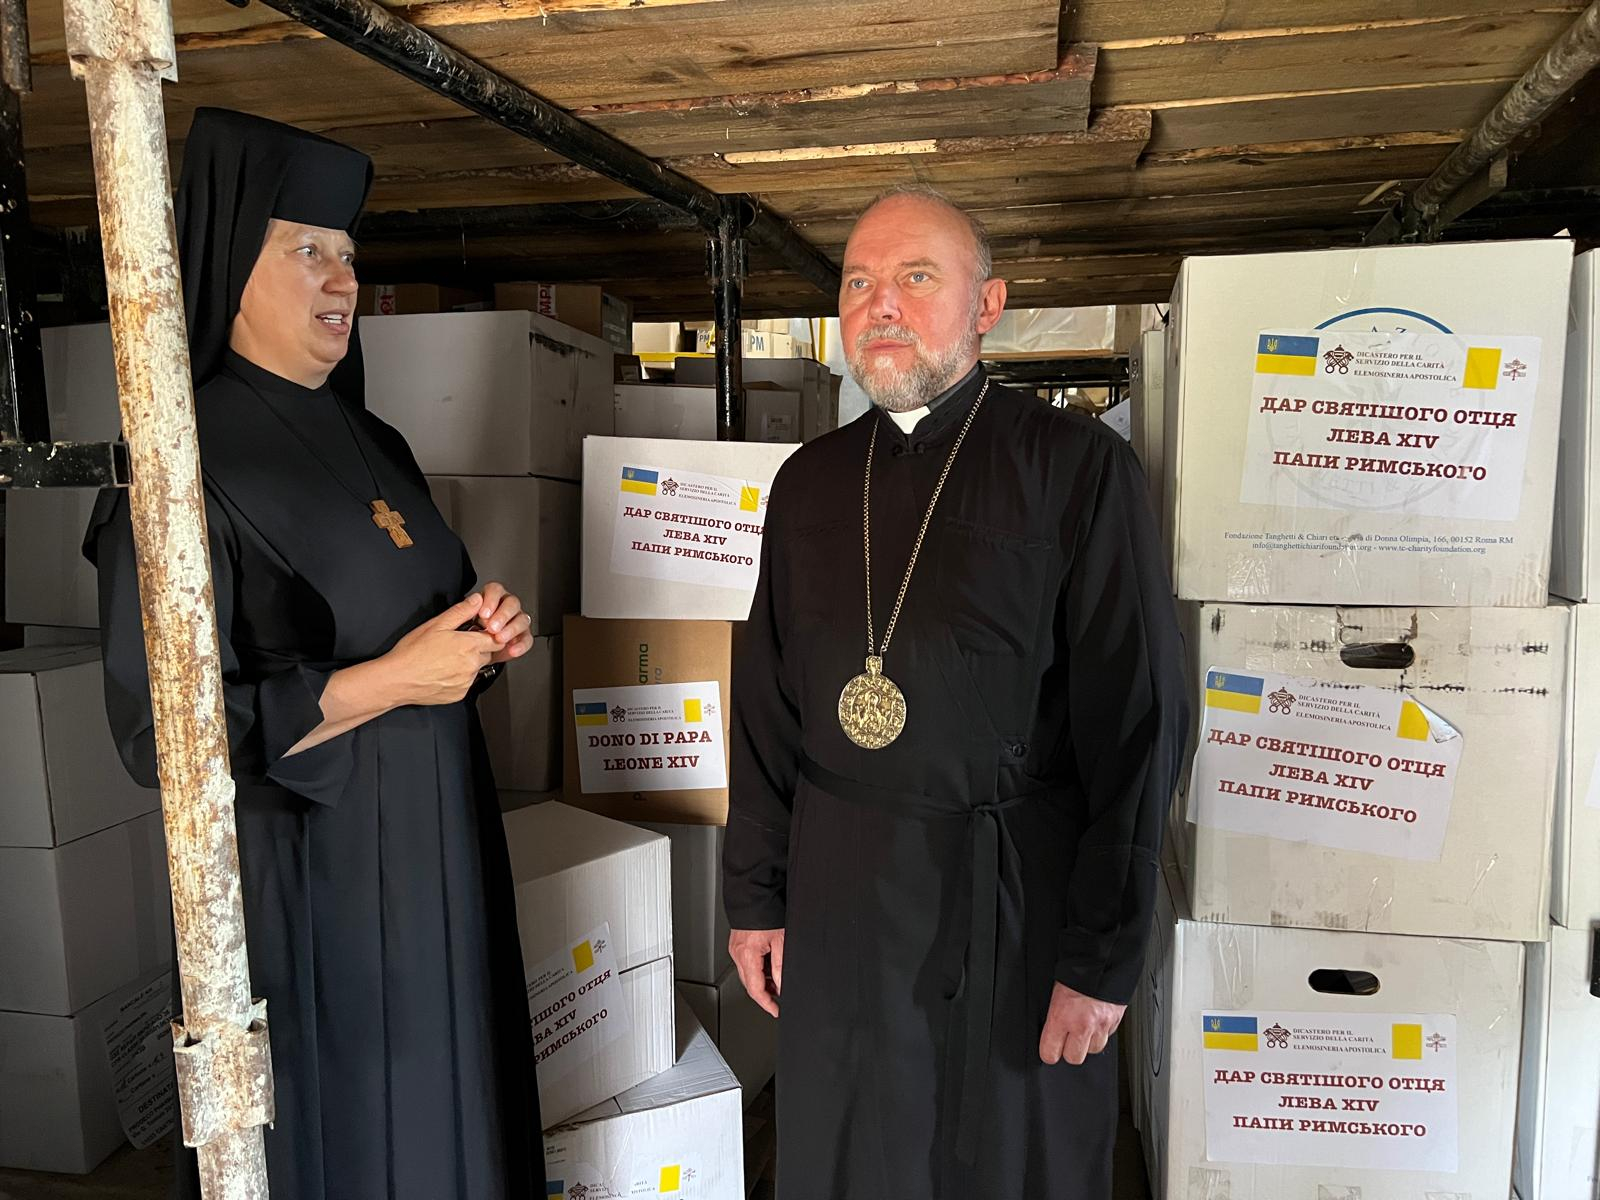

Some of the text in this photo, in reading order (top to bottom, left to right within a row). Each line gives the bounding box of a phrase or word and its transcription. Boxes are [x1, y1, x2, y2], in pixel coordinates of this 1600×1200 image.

[751, 336, 764, 351] PM
[1354, 370, 1456, 381] ELEMOSINERIA APOSTOLICA
[1260, 397, 1517, 429] ДАР СВЯТІШОГО ОТЦЯ
[1327, 429, 1439, 448] ЛЕВА XIV
[1273, 452, 1486, 480] ПАПИ РИМСЬКОГО
[624, 507, 652, 517] ДАР
[655, 511, 731, 530] СВЯТІШОГО
[664, 529, 727, 545] ЛЕВА XIV
[1224, 532, 1263, 540] Fondazione
[1265, 533, 1296, 541] Tanghetti
[1400, 535, 1431, 544] Olimpia,
[1434, 536, 1448, 544] 166,
[632, 541, 753, 566] ПАПИ РИМСЬКОГО
[1297, 701, 1330, 710] SERVIZIO
[1331, 706, 1353, 714] DELLA
[1299, 695, 1337, 705] DICASTERO
[1296, 712, 1391, 730] ELEMOSINERIA APOSTOLICA
[588, 731, 712, 747] DONO DI PAPA
[1208, 728, 1446, 778] ДАР СВЯТІШОГО ОТЦЯ
[603, 756, 699, 770] LEONE XIV
[1269, 764, 1374, 791] ЛЕВА XIV
[1218, 780, 1417, 823] ПАПИ РИМСЬКОГО
[532, 992, 575, 1026] ІШОГО
[578, 970, 611, 995] ОТЦЯ
[534, 1009, 576, 1045] ВА XIV
[1293, 1044, 1343, 1052] ELEMOSINERIA
[1214, 1070, 1445, 1093] ДАР СВЯТІШОГО ОТЦЯ
[1278, 1096, 1379, 1112] ЛЕВА XIV
[1233, 1116, 1426, 1137] ПАПИ РИМСЬКОГО
